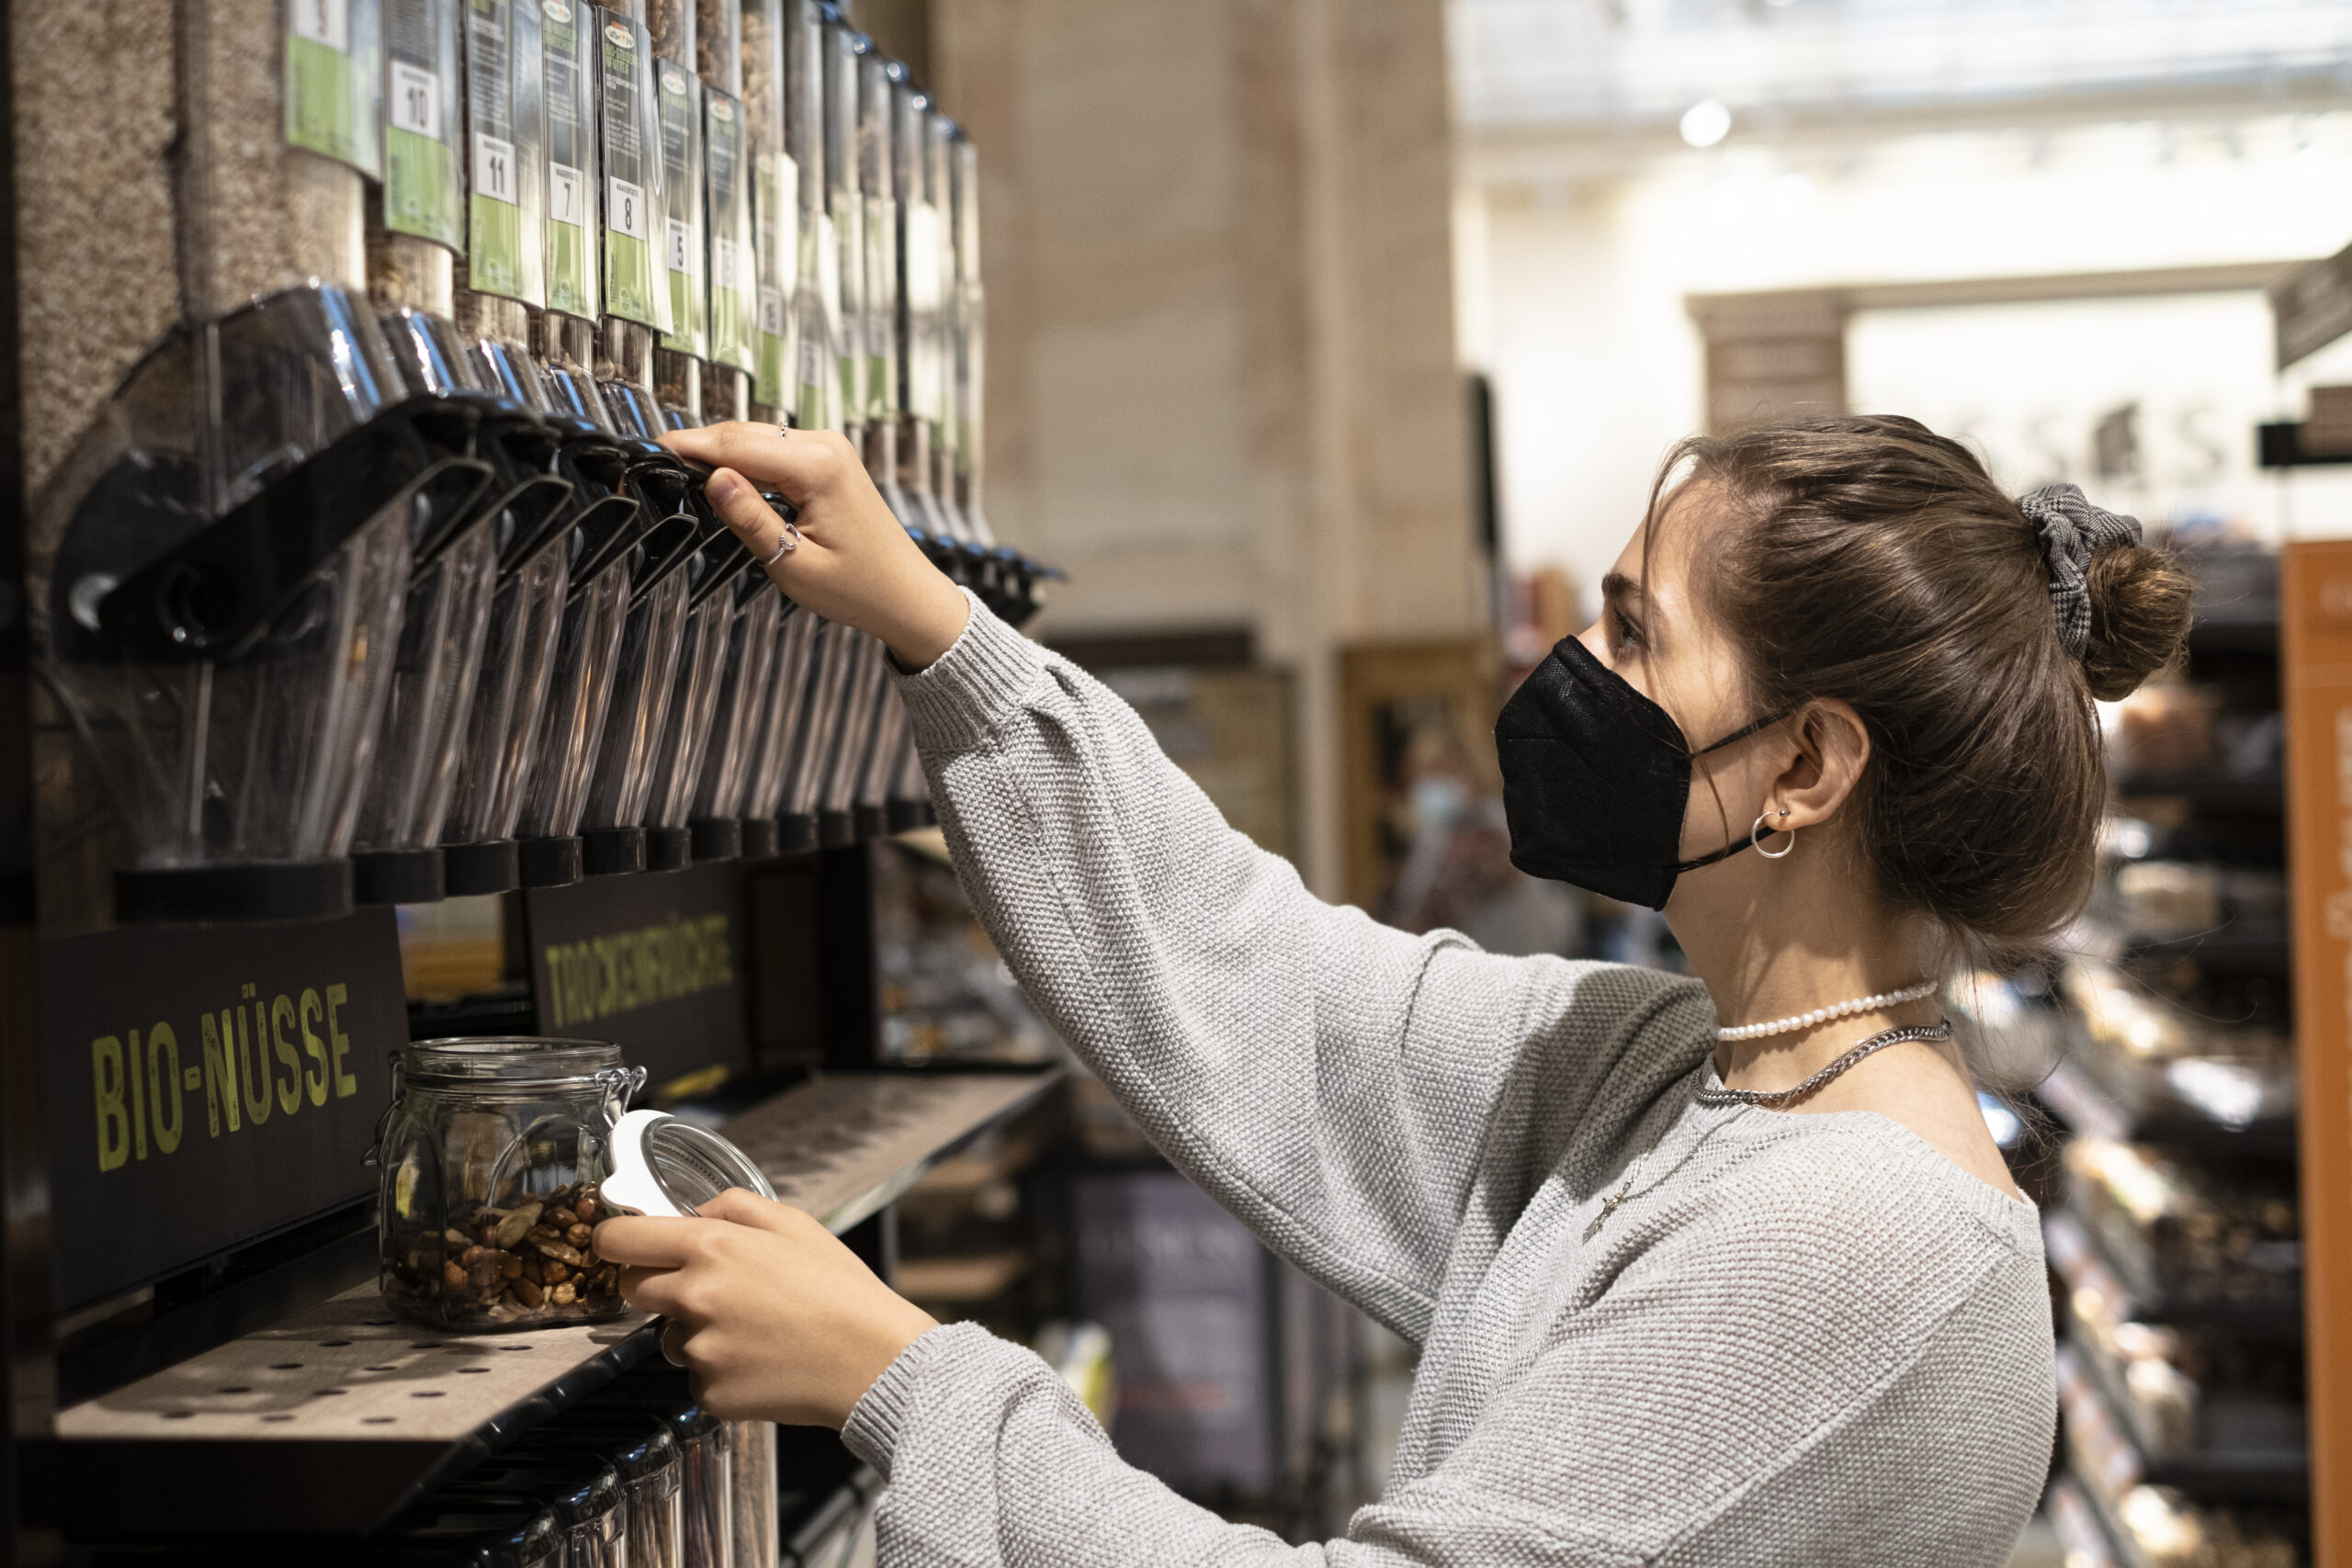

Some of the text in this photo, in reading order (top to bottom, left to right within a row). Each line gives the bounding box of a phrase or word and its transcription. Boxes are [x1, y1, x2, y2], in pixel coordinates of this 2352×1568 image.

[407, 87, 429, 129] 10
[490, 155, 504, 195] 11
[563, 182, 571, 218] 7
[625, 197, 632, 231] 8
[677, 235, 684, 267] 5
[93, 982, 357, 1173] BIO-NÜSSE
